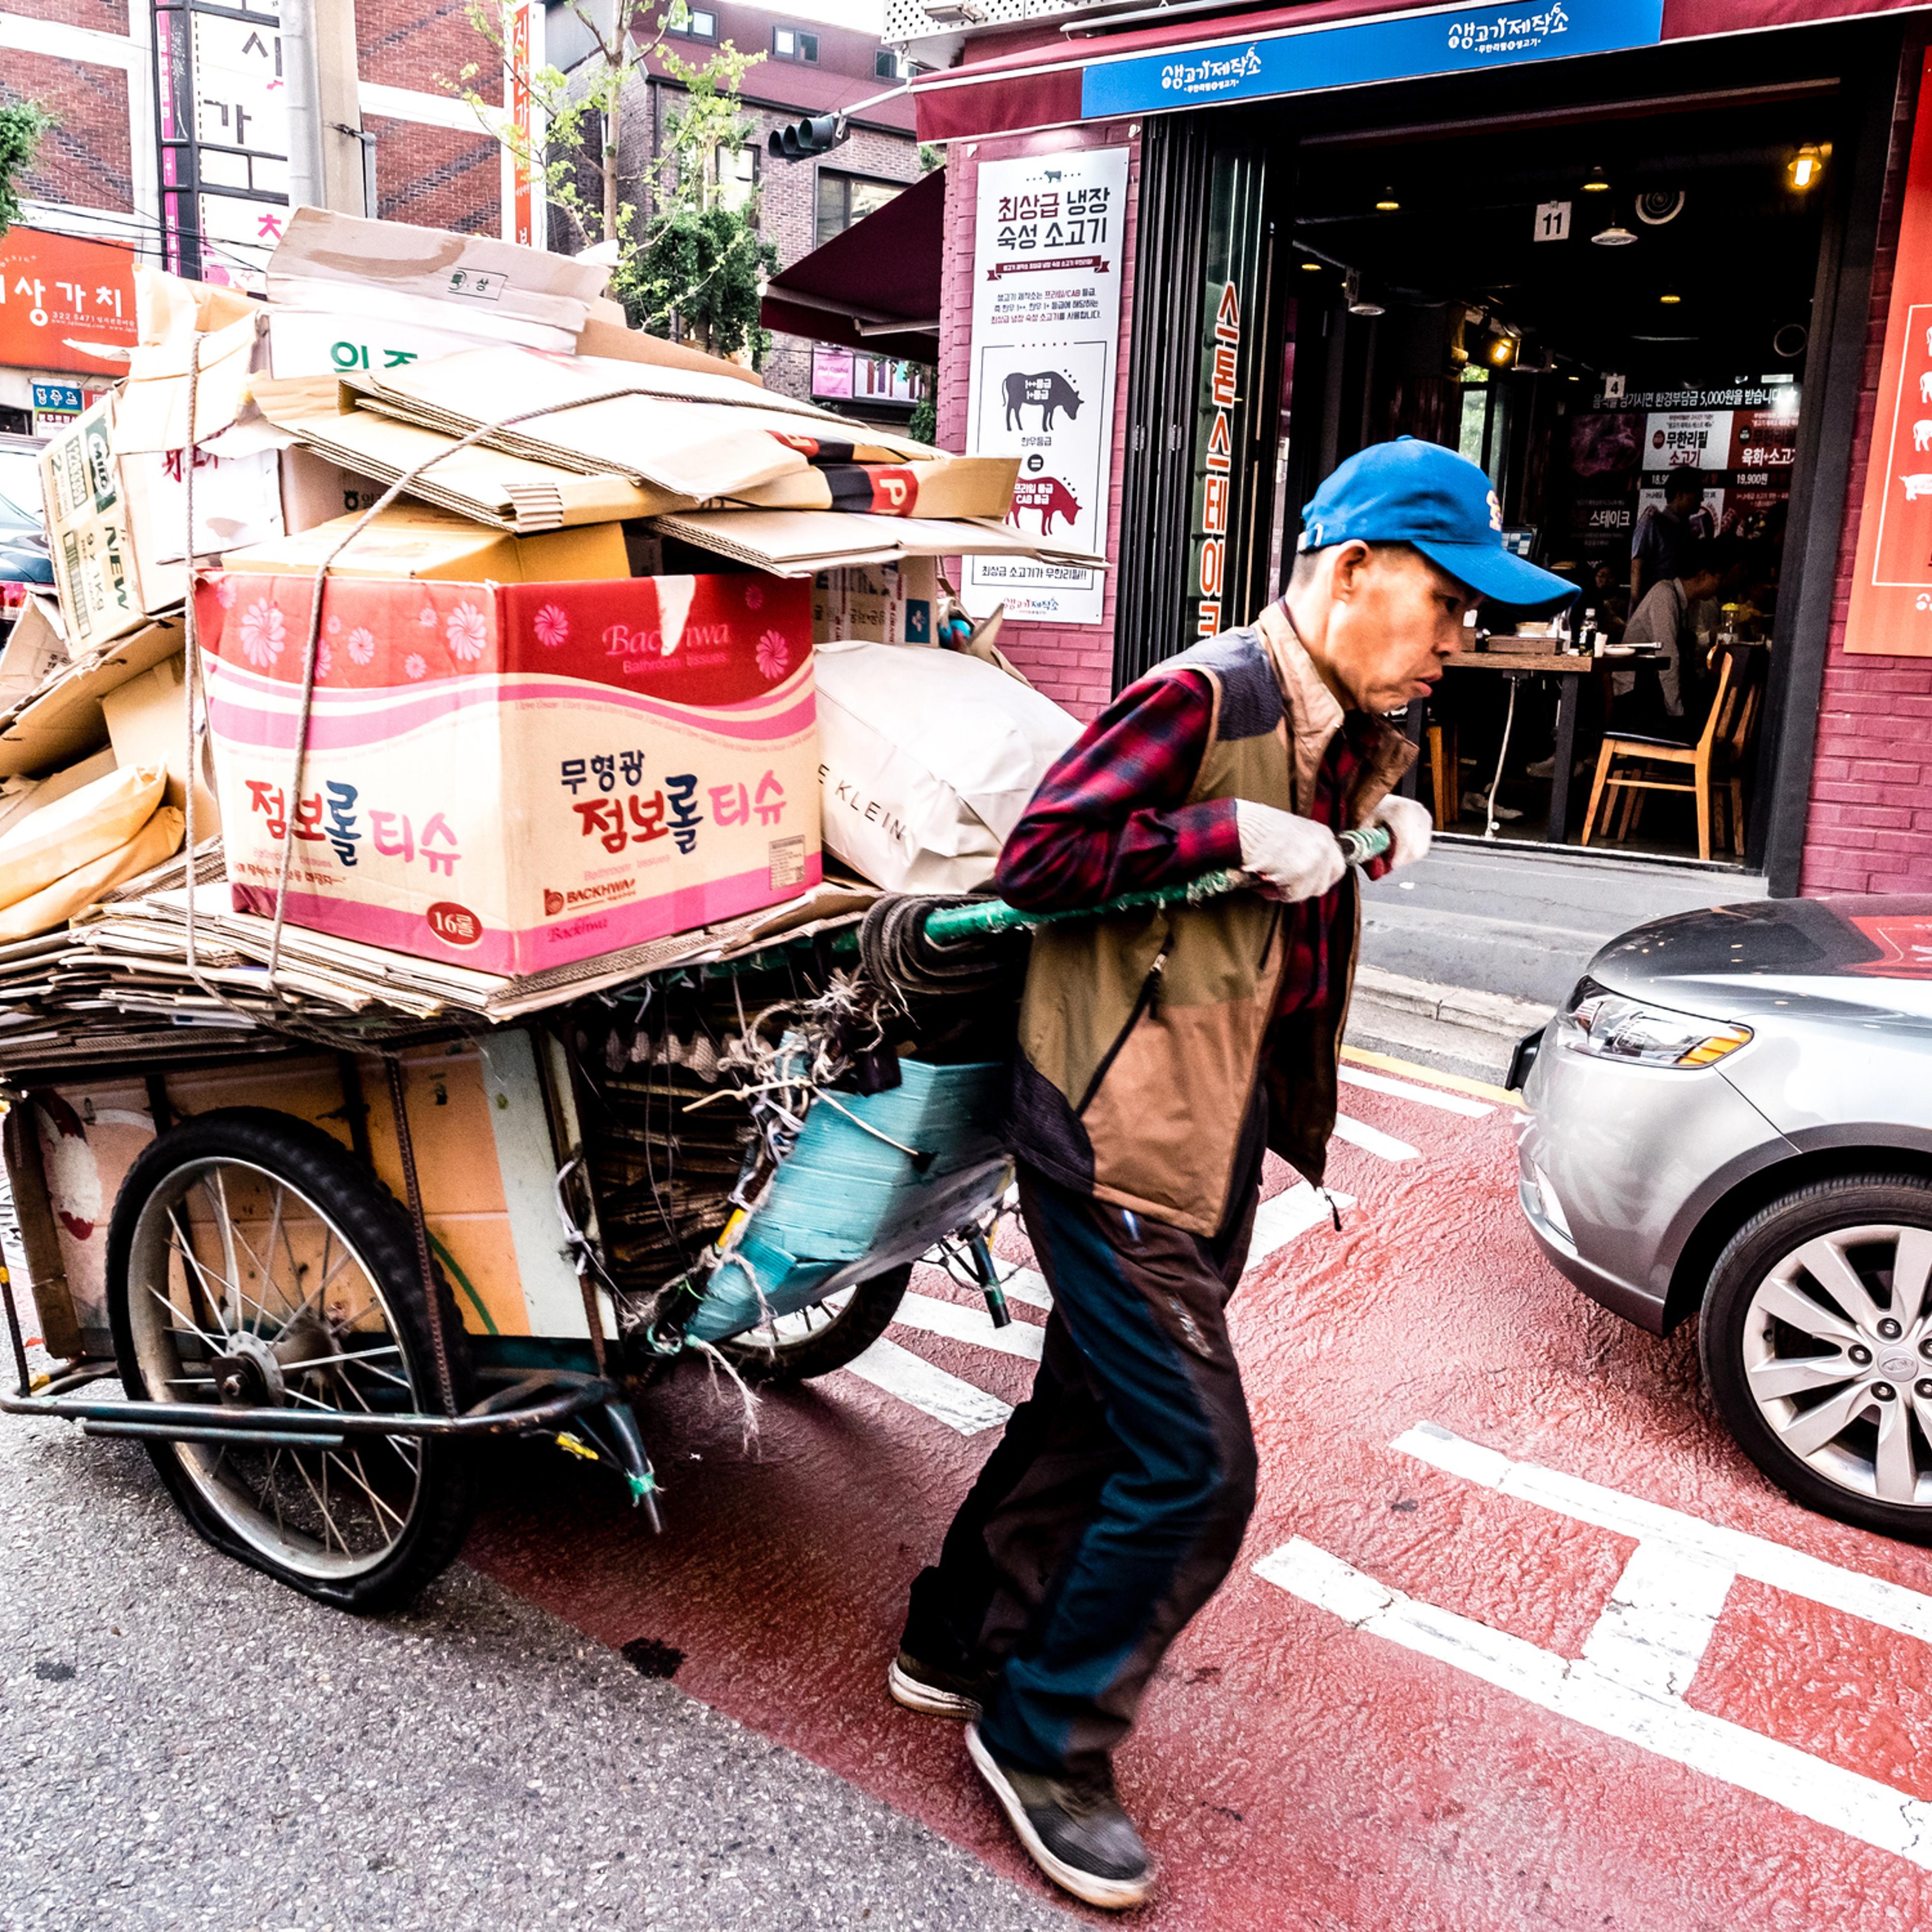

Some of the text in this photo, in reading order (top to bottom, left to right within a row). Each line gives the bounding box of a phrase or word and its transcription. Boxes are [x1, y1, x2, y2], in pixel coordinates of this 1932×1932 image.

[1448, 3, 1569, 49] 생고기제작소
[1162, 46, 1261, 89] 생고기제작소
[998, 187, 1110, 222] 최상급 냉장
[997, 217, 1107, 250] 숙성 소고기
[1543, 212, 1563, 235] 11
[52, 311, 70, 320] 322
[74, 313, 95, 323] 5471
[1611, 381, 1619, 394] 4
[1655, 389, 1699, 406] 환경부담금
[1700, 389, 1743, 407] 5,000원을
[1021, 437, 1052, 447] 한우등급
[1666, 430, 1709, 449] 무한리필
[1669, 449, 1701, 467] 소고기
[1737, 473, 1768, 486] 19,900원
[1589, 511, 1630, 528] 스테이크
[104, 527, 129, 610] NEW
[982, 566, 1007, 577] 최상급
[1009, 567, 1043, 579] 소고기가
[623, 658, 682, 674] Bathroom
[561, 750, 645, 794] 무형광
[572, 769, 787, 855] 점보롤 티슈
[835, 780, 906, 842] KLEIN
[245, 780, 361, 867] 점보롤
[368, 812, 461, 876] 티슈
